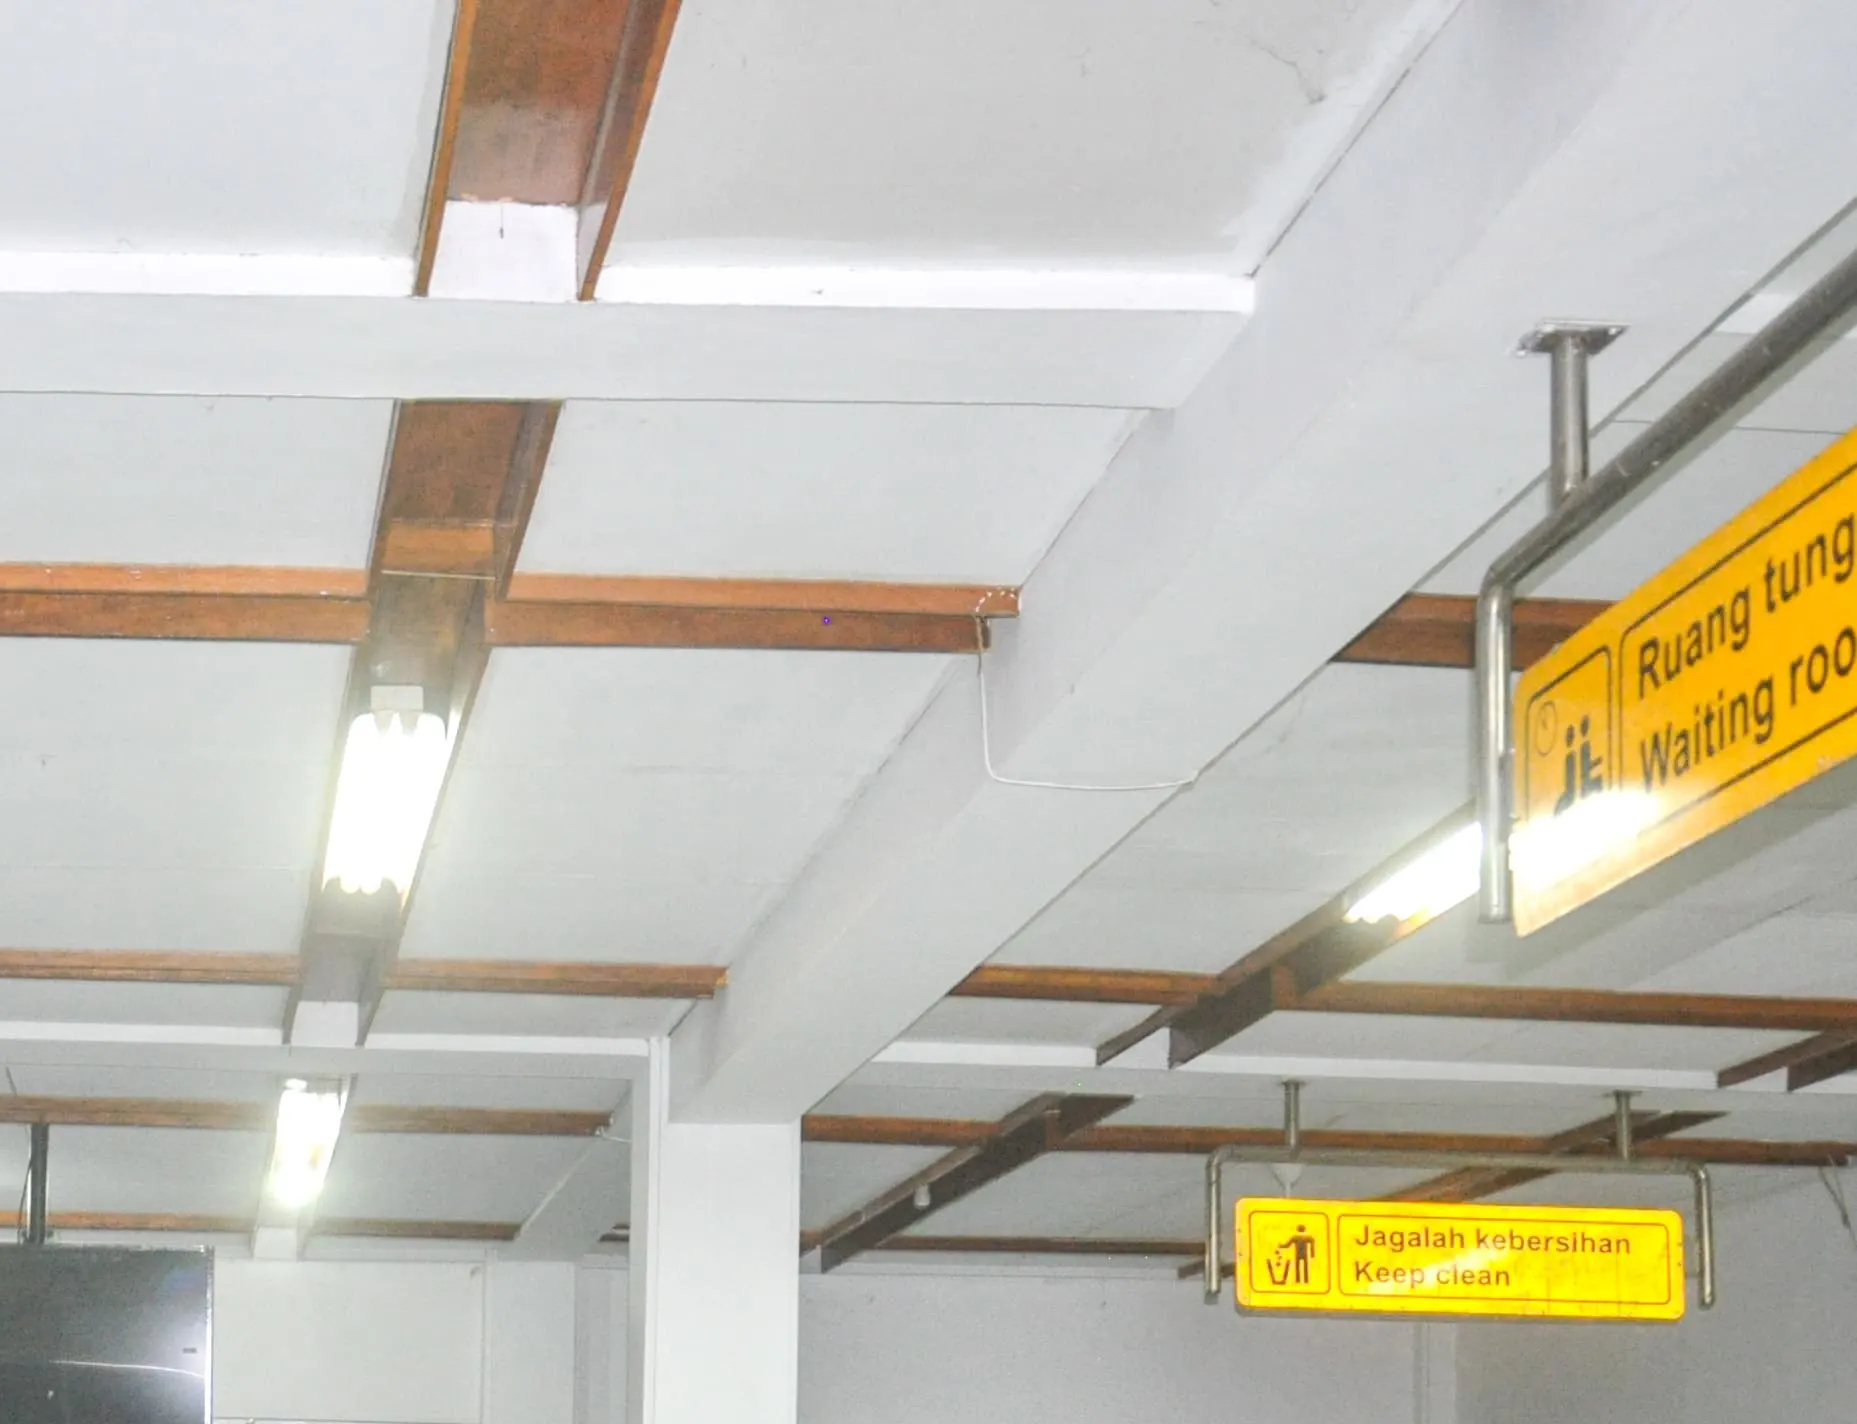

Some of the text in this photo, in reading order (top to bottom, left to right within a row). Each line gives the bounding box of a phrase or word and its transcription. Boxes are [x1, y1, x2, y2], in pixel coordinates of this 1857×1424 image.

[1638, 512, 1855, 700] Ruang tung
[1639, 625, 1857, 794] Waiting roo
[1354, 1262, 1511, 1288] Keep clean
[1355, 1224, 1631, 1255] Jagalah kebersihan
